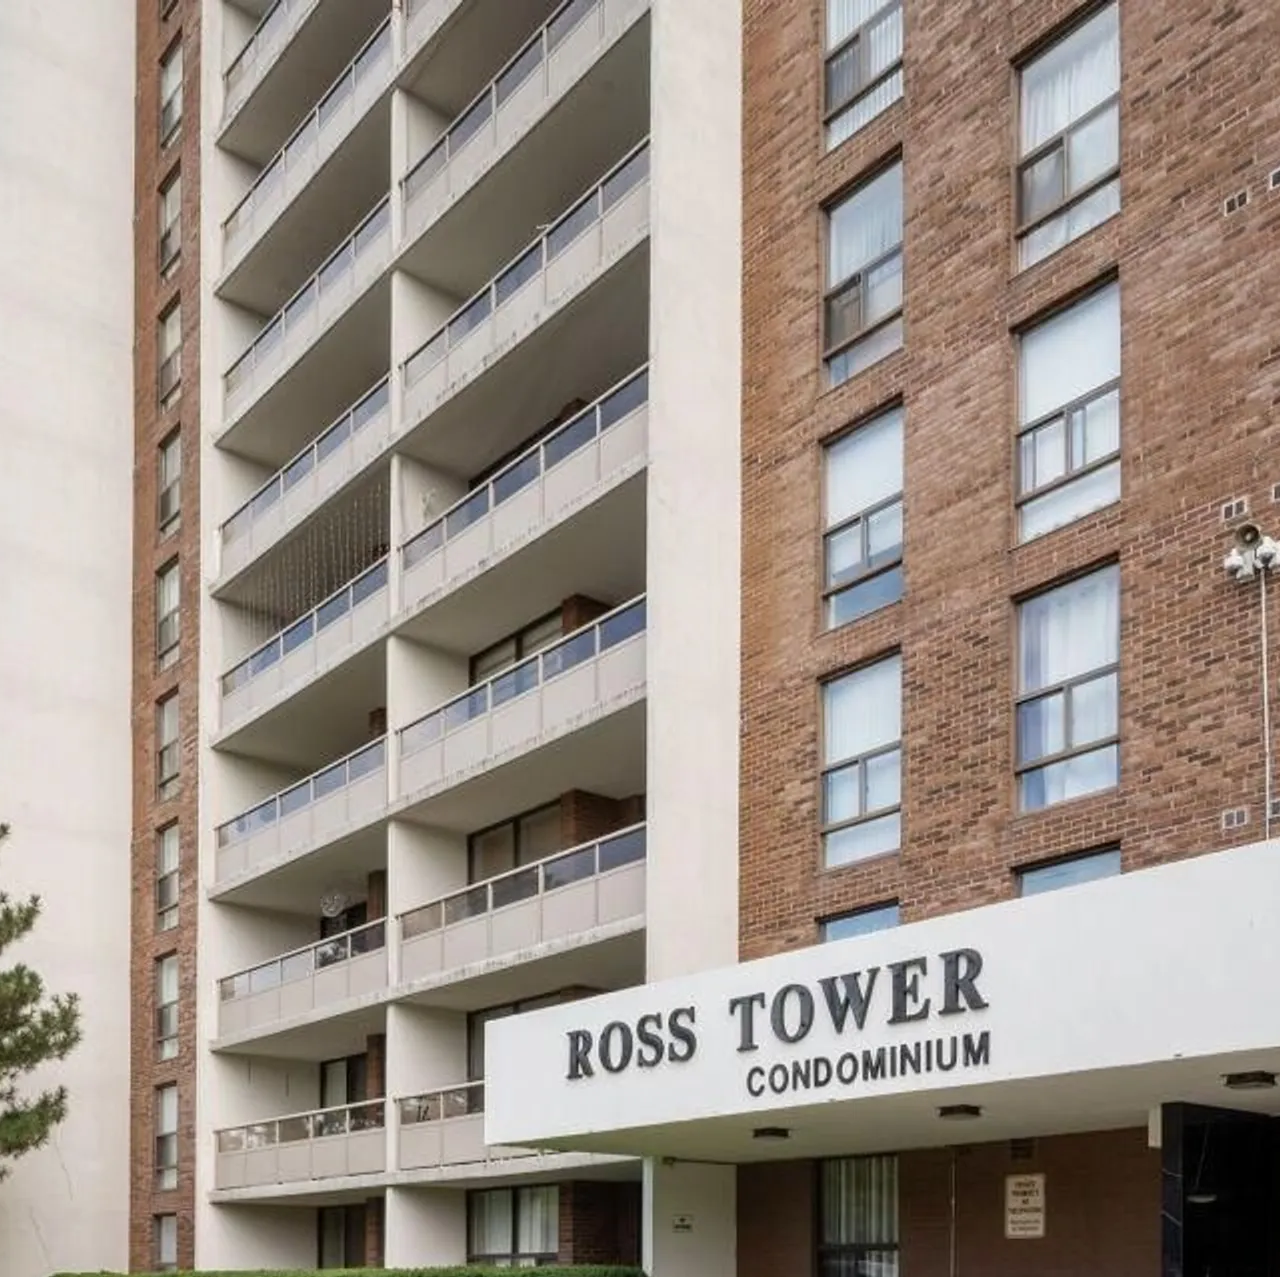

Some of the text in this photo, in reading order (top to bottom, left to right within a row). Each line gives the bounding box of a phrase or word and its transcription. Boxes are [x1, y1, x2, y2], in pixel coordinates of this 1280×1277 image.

[566, 947, 989, 1080] ROSS TOWER
[746, 1030, 991, 1097] CONDOMINIUM
